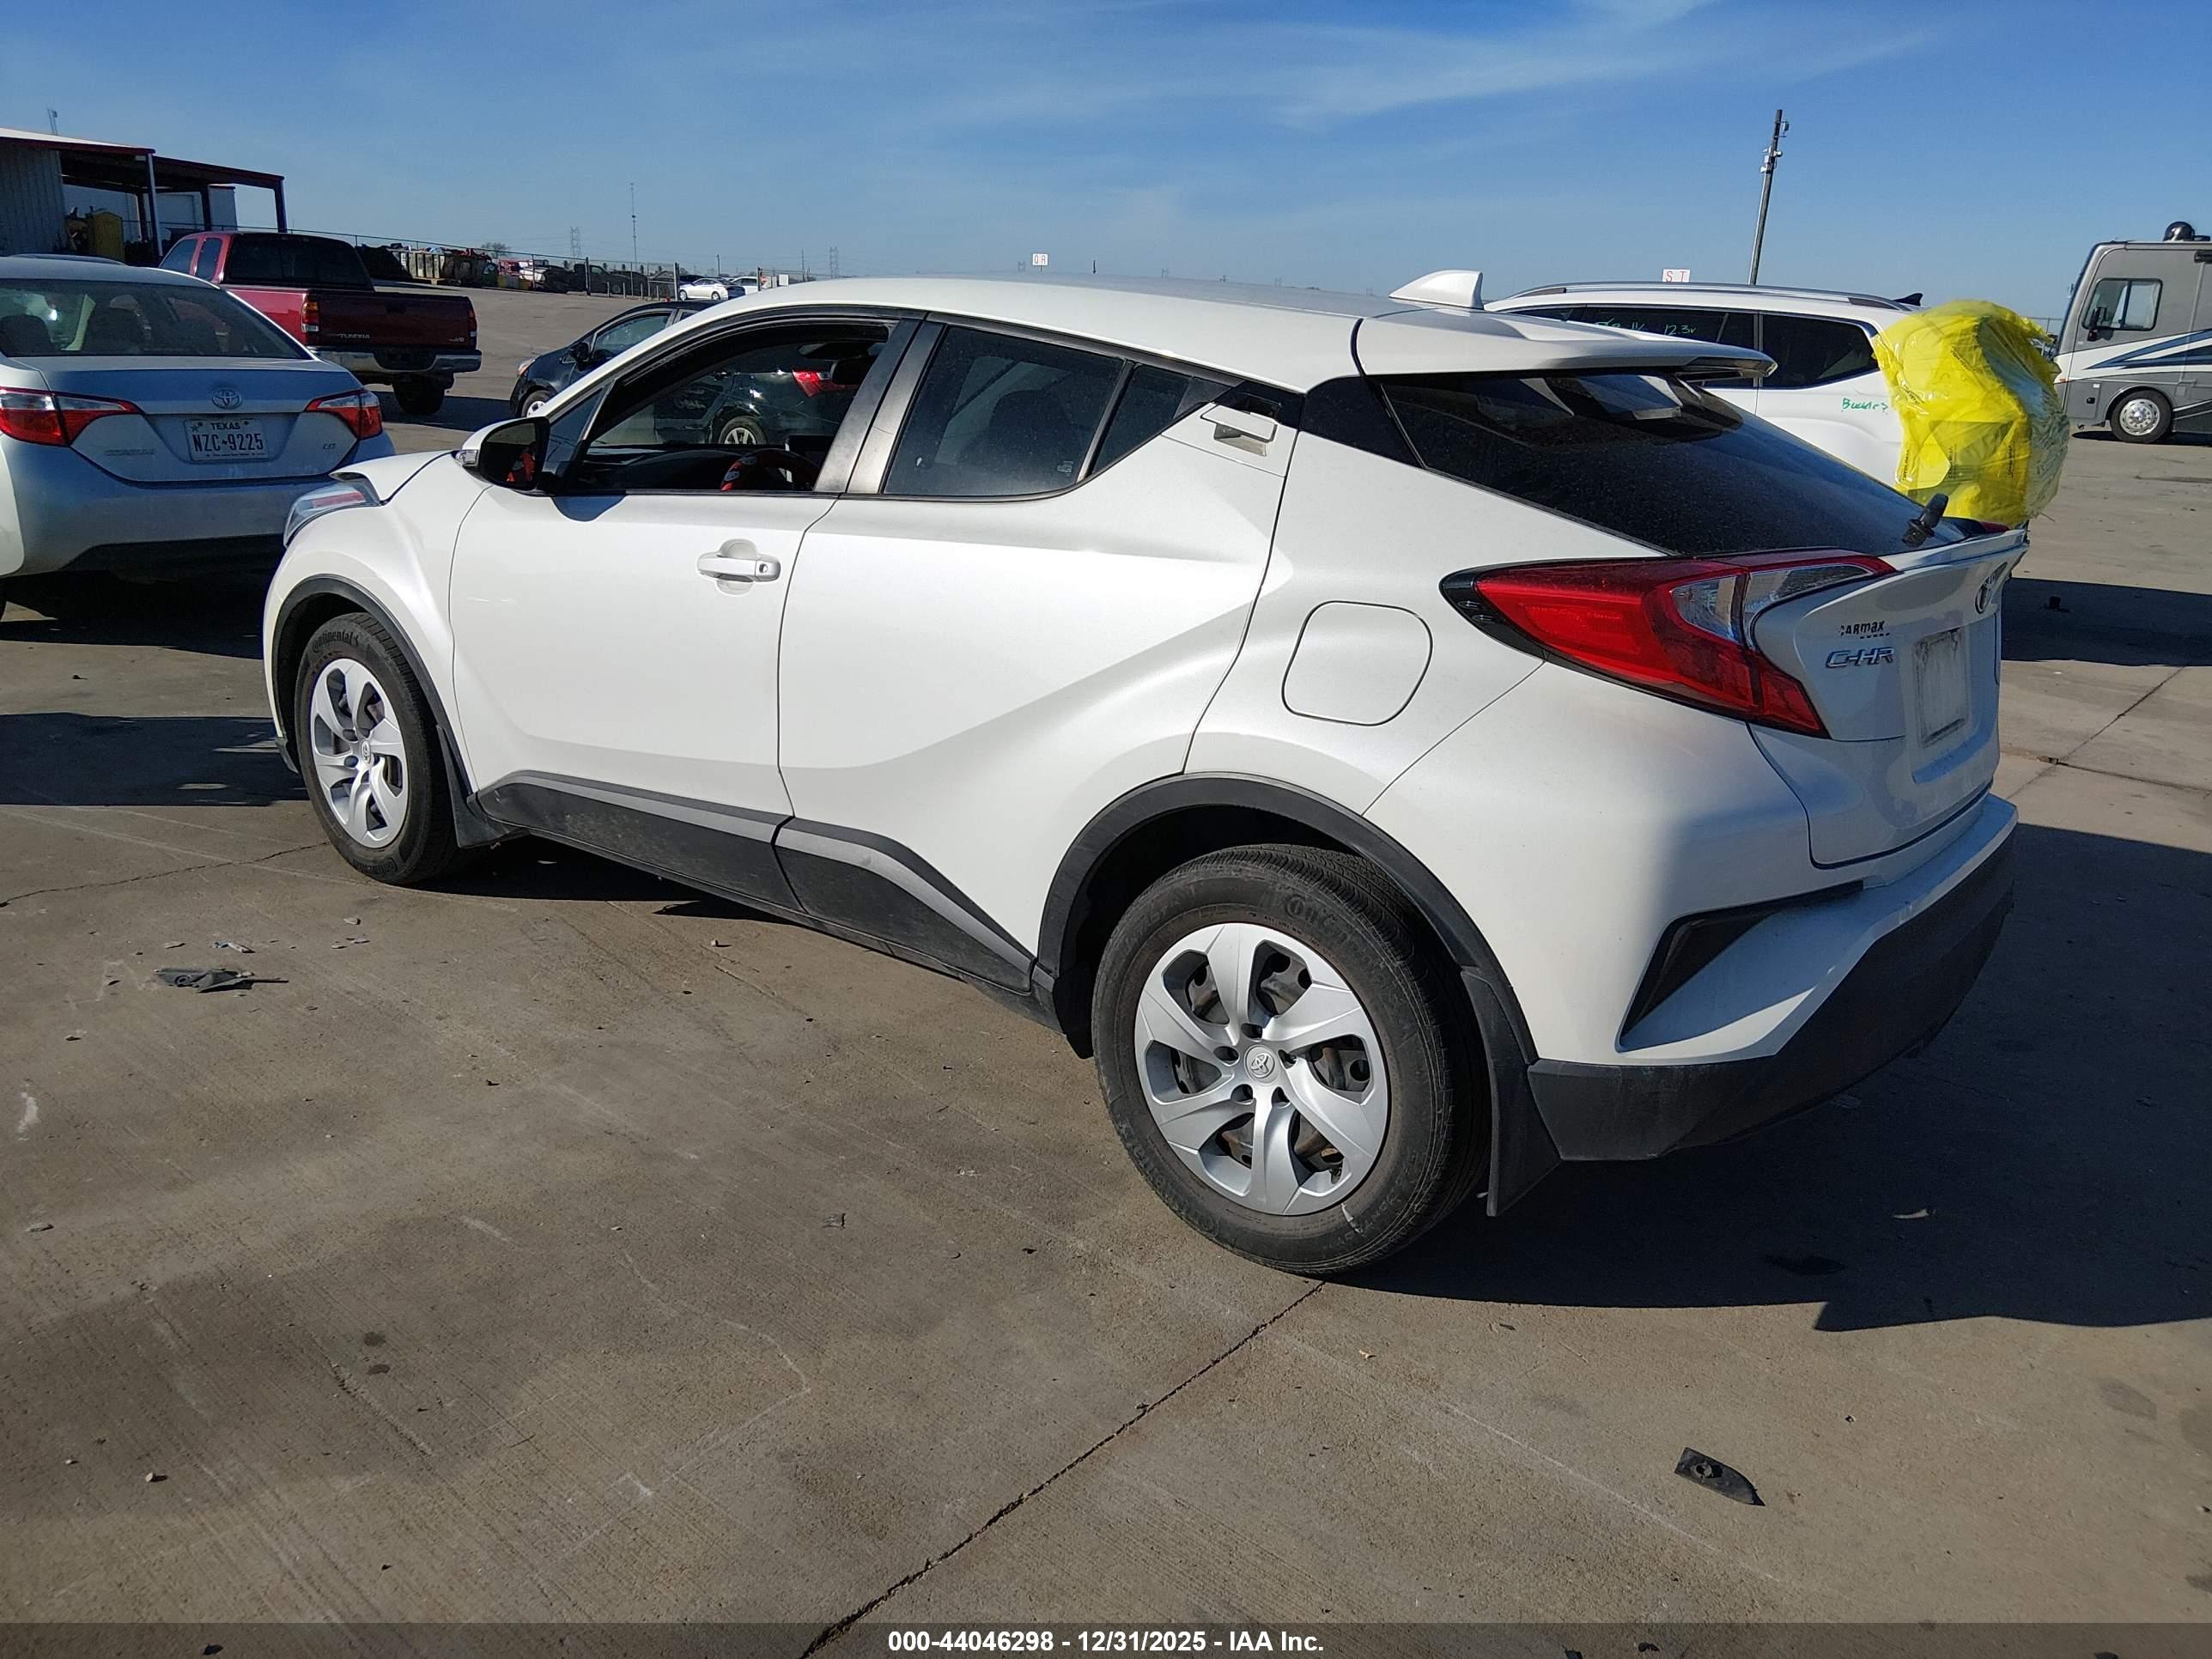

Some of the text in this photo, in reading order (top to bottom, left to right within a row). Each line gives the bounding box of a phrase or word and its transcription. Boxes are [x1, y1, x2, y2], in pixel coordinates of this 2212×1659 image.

[1666, 270, 1686, 282] S T
[1826, 647, 1894, 668] C-HR
